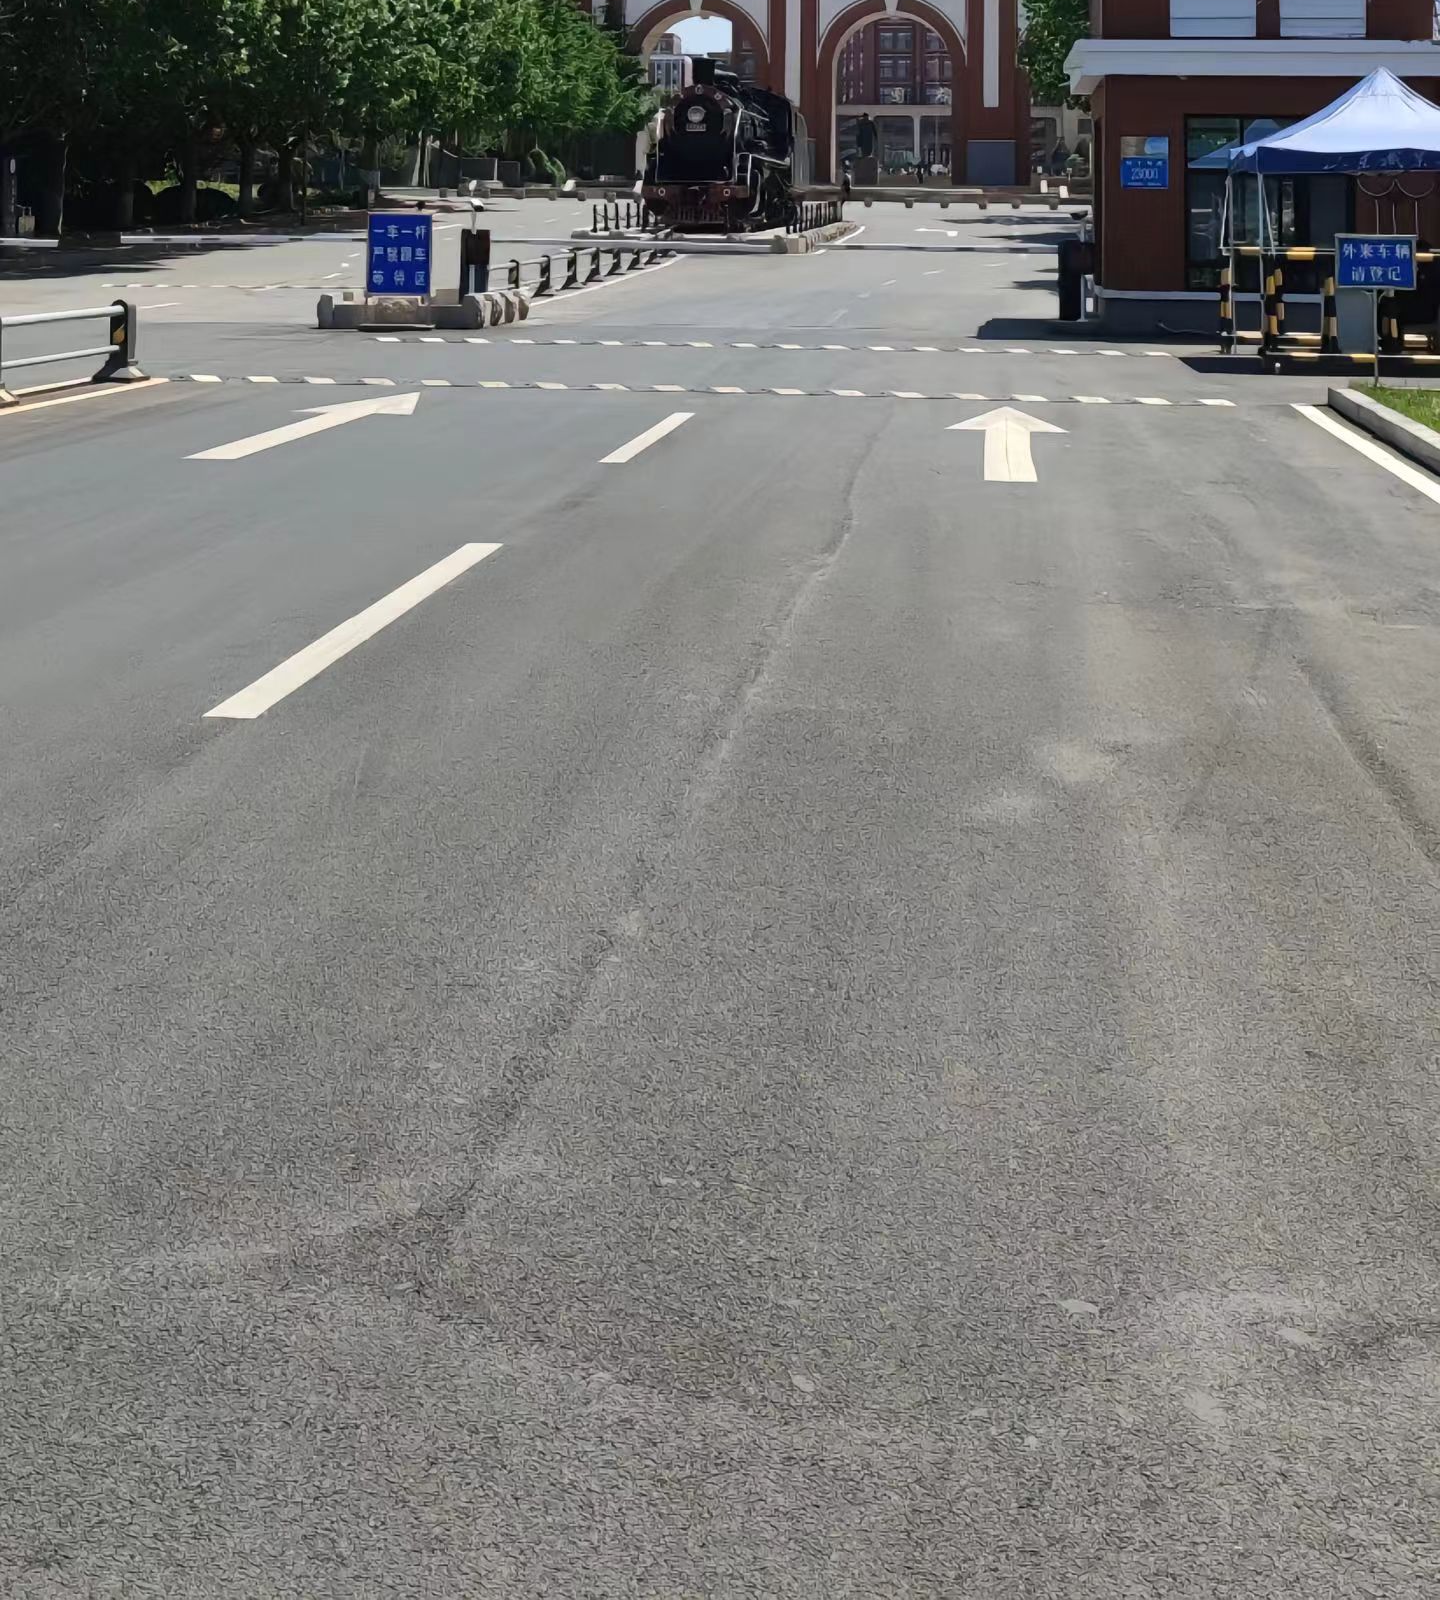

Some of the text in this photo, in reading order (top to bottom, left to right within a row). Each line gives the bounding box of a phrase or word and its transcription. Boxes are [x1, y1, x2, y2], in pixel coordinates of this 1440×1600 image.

[372, 224, 428, 240] 一车一杆
[1342, 243, 1411, 260] 外来车辆
[1351, 265, 1402, 282] 请登记
